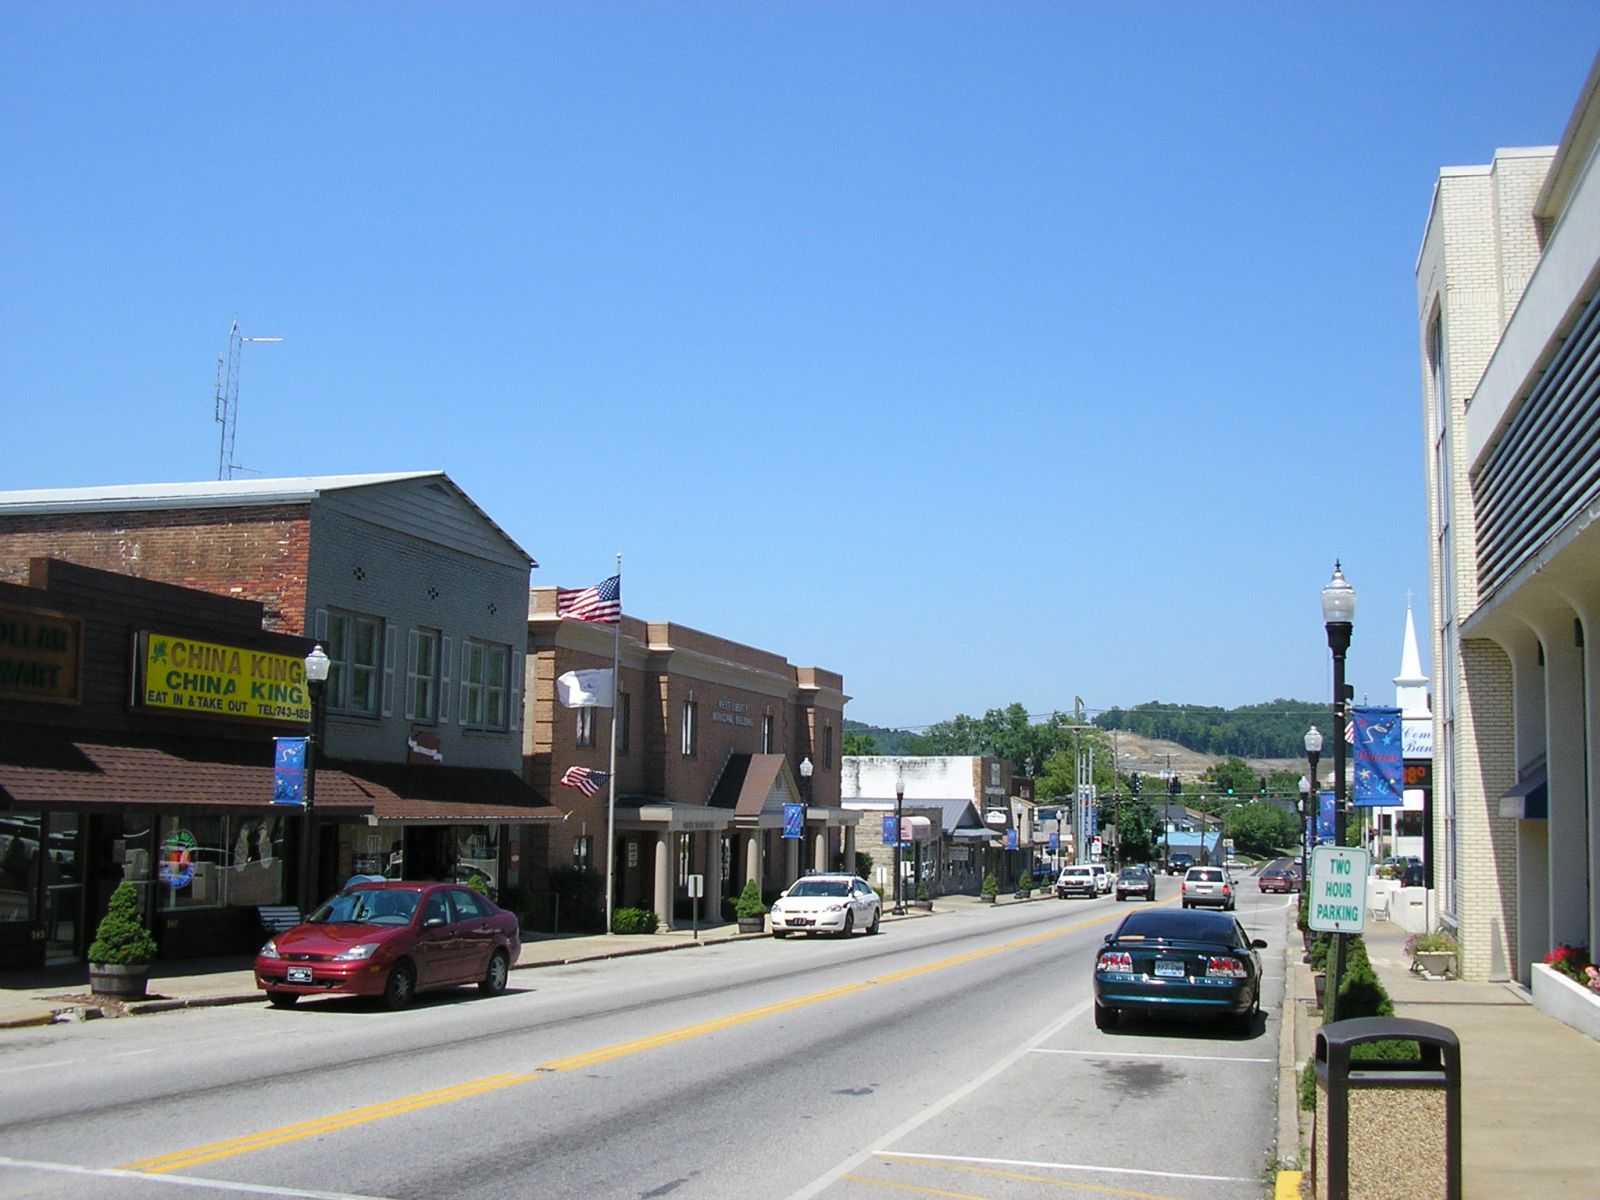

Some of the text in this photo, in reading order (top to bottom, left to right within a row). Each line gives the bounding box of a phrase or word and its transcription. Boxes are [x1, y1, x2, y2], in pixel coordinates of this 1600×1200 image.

[171, 641, 302, 685] CHINA KING
[166, 670, 303, 705] CHINA KING
[148, 690, 168, 704] EAT
[173, 693, 183, 705] IN
[188, 693, 195, 706] &
[197, 696, 223, 710] TAKE
[227, 700, 248, 713] OUT
[1330, 858, 1351, 875] TWO
[1325, 881, 1352, 898] HOUR
[1317, 904, 1359, 921] PARKING
